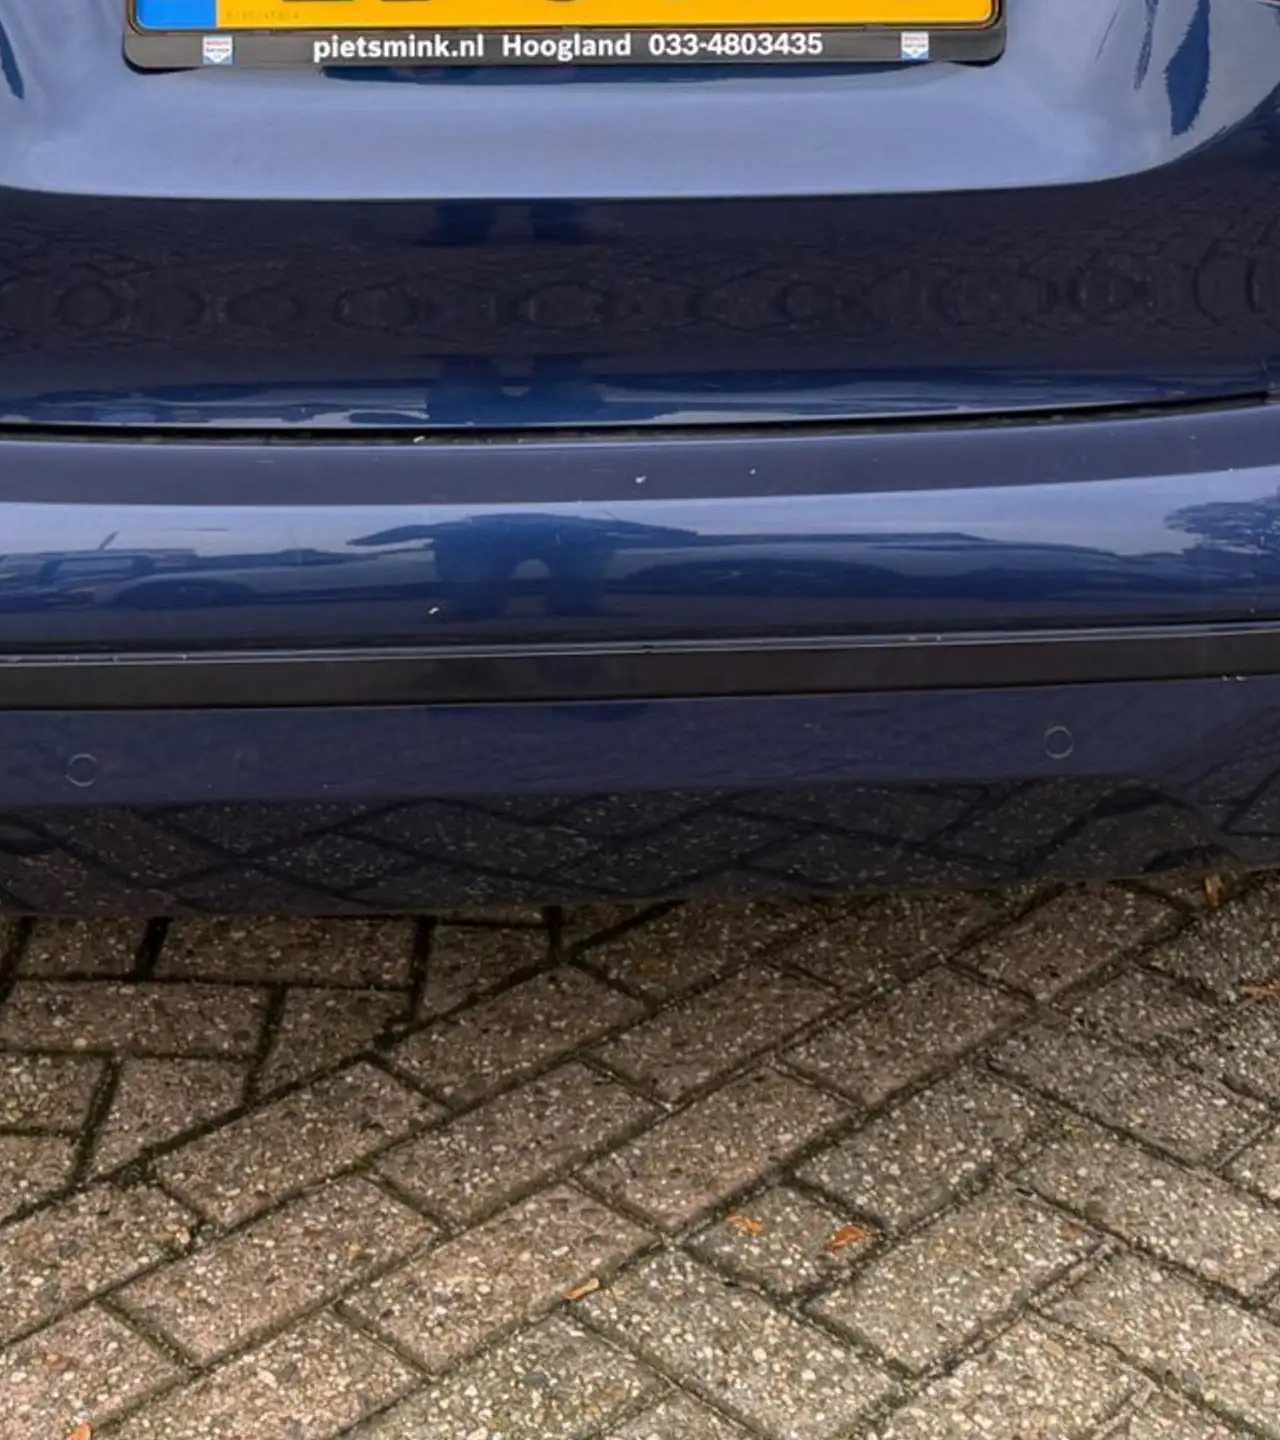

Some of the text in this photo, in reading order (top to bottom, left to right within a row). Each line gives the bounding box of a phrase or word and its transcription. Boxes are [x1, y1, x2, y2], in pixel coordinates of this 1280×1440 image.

[313, 32, 824, 63] pietsmink.nl Hoogland 033-4803435
